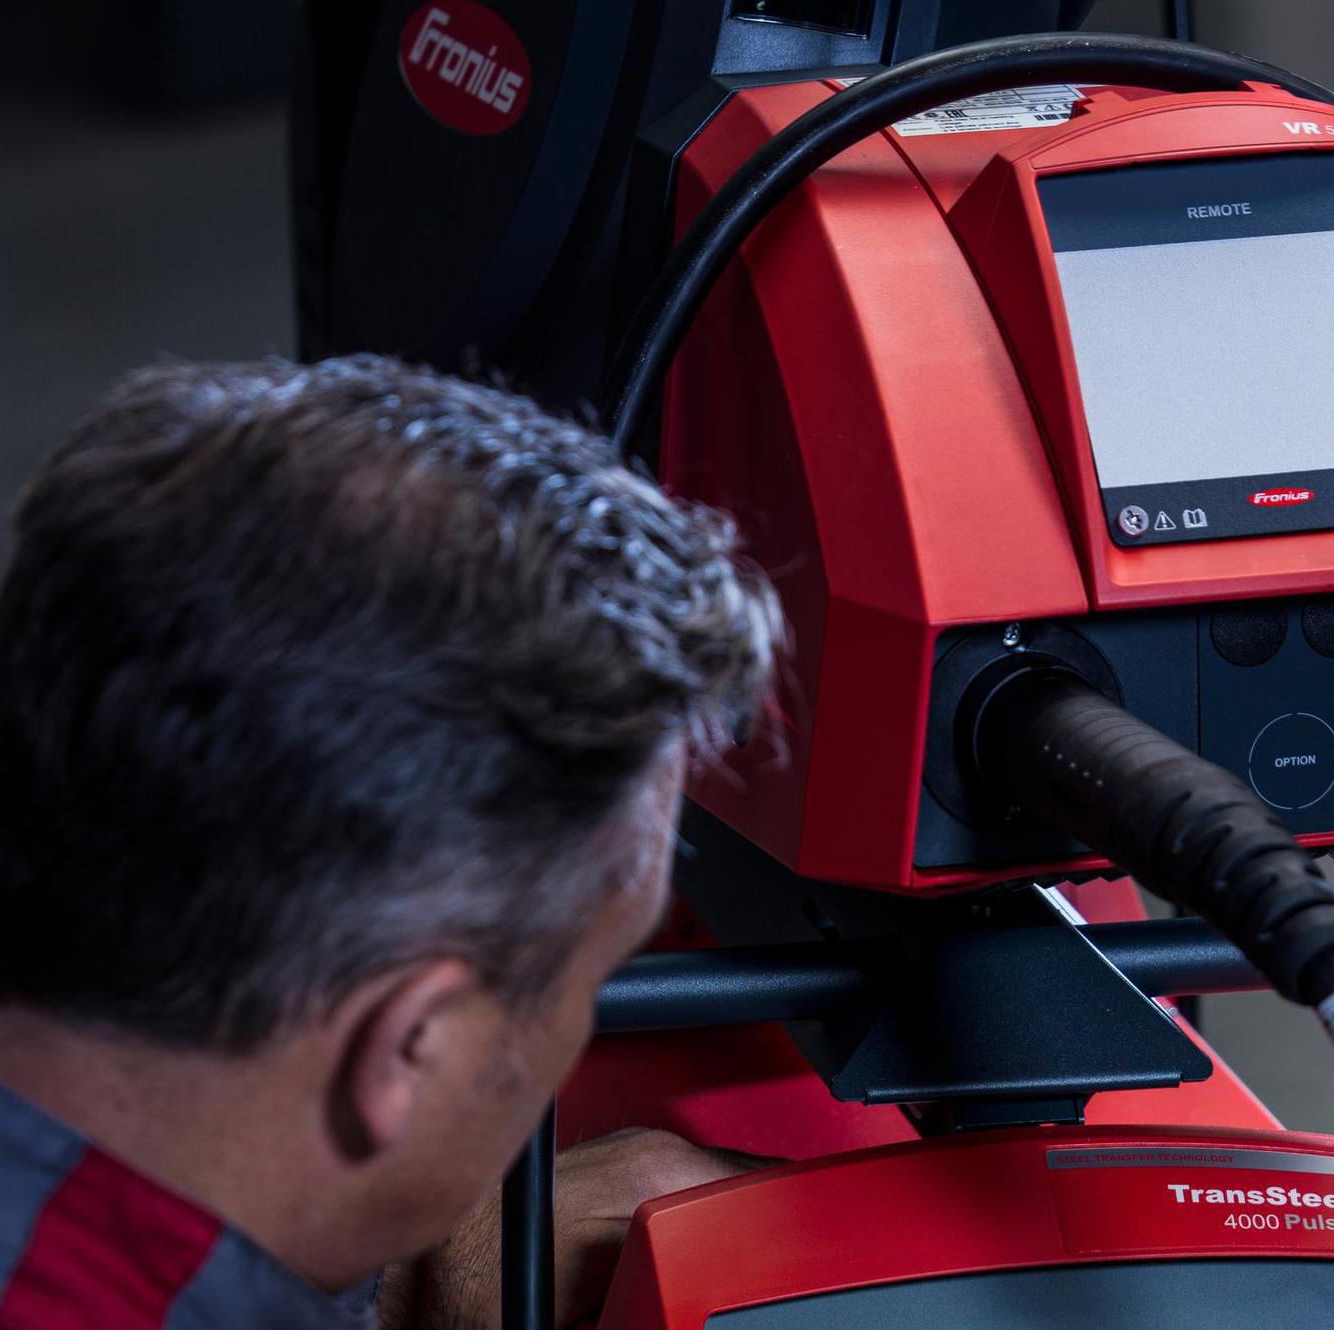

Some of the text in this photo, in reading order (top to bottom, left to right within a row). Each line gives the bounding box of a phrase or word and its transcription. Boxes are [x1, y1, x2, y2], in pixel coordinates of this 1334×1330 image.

[410, 8, 524, 114] Fronius
[1283, 122, 1322, 135] VR
[1187, 203, 1252, 219] REMOTE
[1253, 491, 1309, 504] Fronius
[1275, 755, 1316, 767] OPTION
[1096, 1154, 1154, 1162] TRANSFER
[1158, 1153, 1234, 1163] TECHNOLOGY
[1224, 1214, 1280, 1230] 4000
